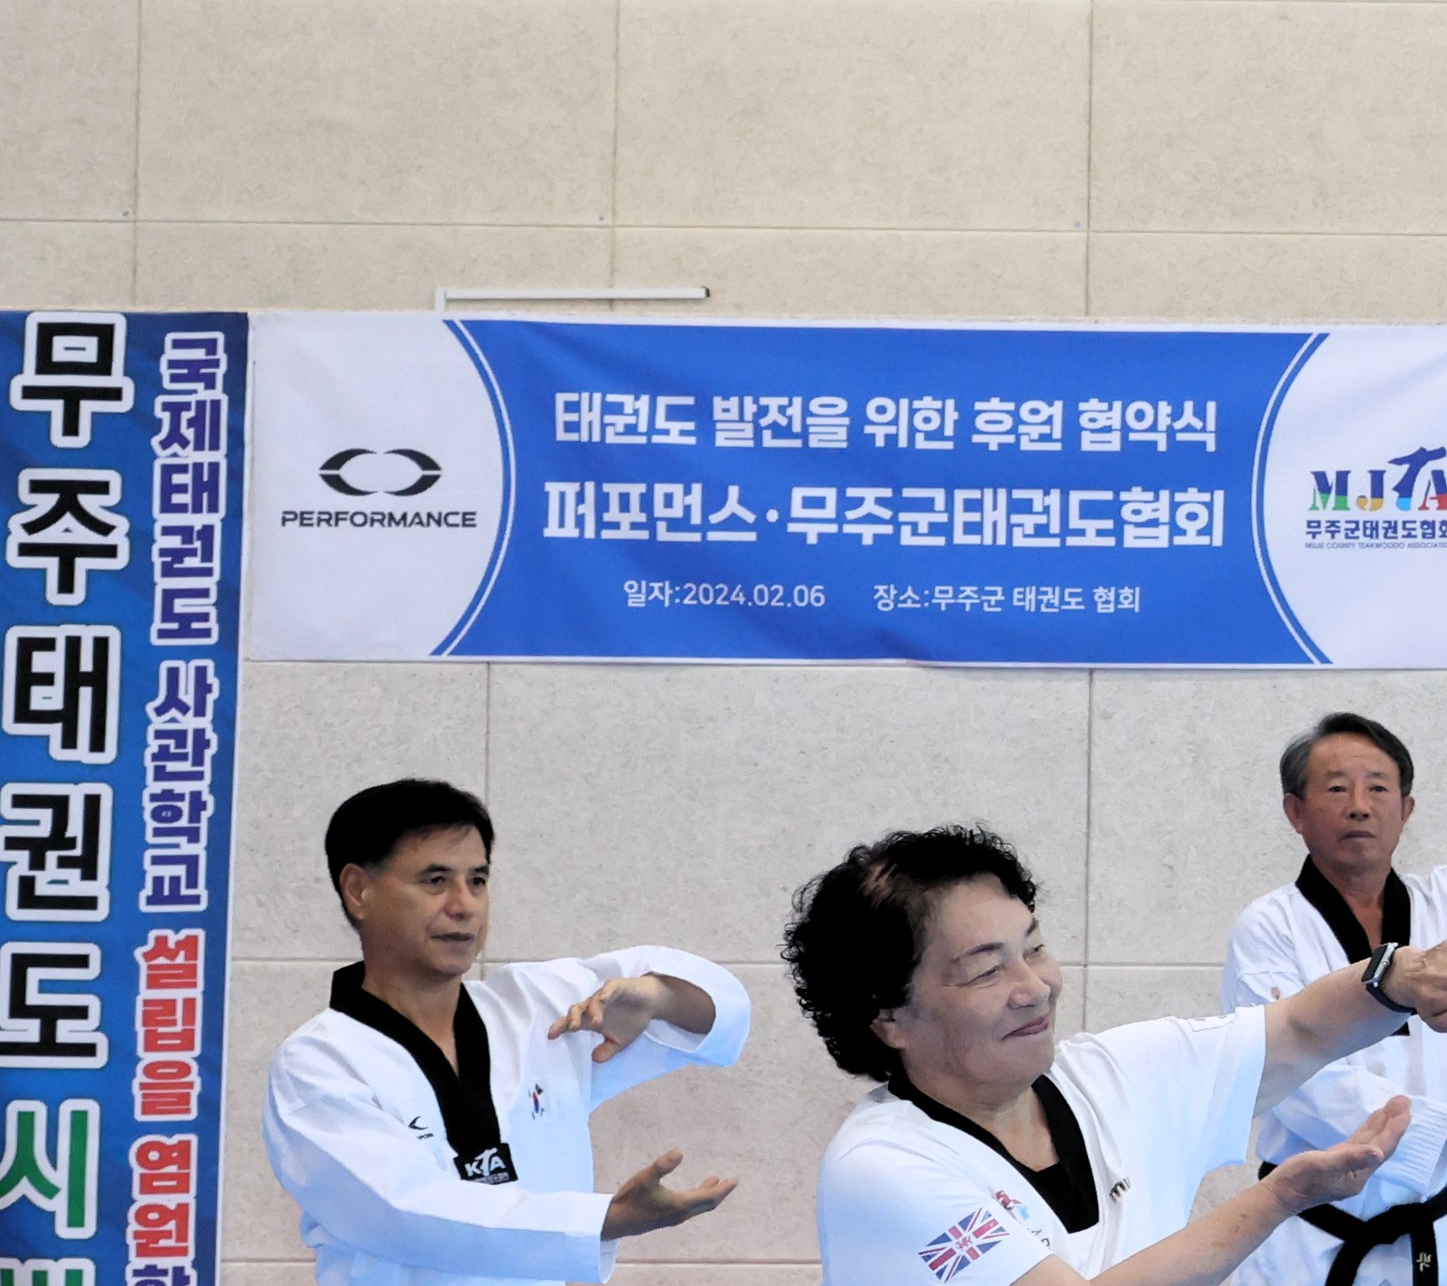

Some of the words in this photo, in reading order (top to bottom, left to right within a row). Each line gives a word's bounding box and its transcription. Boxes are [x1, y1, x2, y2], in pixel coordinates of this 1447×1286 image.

[555, 392, 697, 445] 태권도
[712, 395, 851, 448] 발전을
[864, 395, 959, 450] 위한
[971, 396, 1064, 452] 후원
[1077, 397, 1217, 453] 협약식
[151, 332, 229, 645] 국제태권도
[281, 510, 477, 528] PERFORMANCE
[543, 480, 1225, 548] 퍼포먼스·무주군태권도협회
[1012, 584, 1086, 613] 태권도
[1092, 585, 1141, 614] 협회
[139, 660, 219, 913] 사관학교
[132, 927, 205, 1122] 설립을
[463, 1146, 506, 1178] KTA
